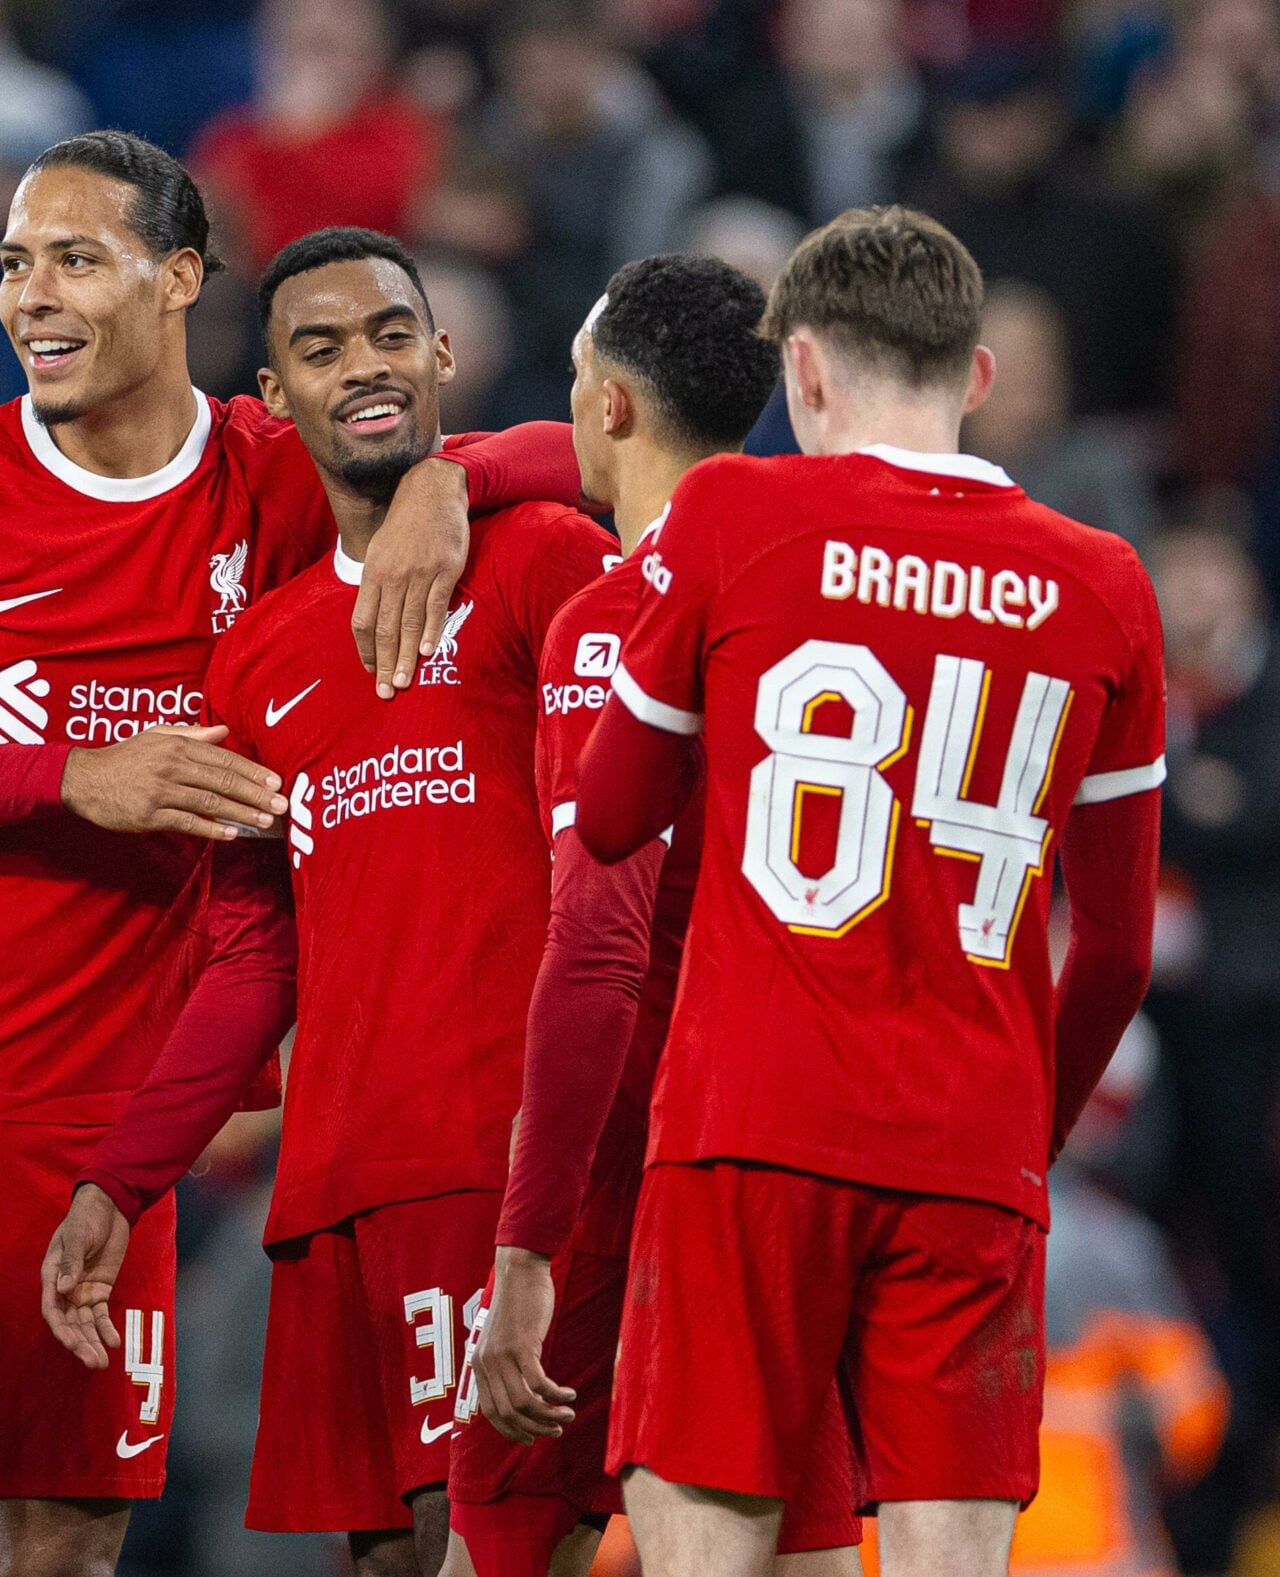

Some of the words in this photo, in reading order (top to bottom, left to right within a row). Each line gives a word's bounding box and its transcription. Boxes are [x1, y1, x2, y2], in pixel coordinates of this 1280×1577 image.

[820, 540, 1059, 631] BRADLEY
[418, 666, 462, 686] L.F.C.
[542, 682, 613, 716] Expe
[321, 740, 463, 801] standard
[322, 772, 476, 829] chartered
[741, 638, 1075, 970] 84
[125, 1309, 165, 1425] 4
